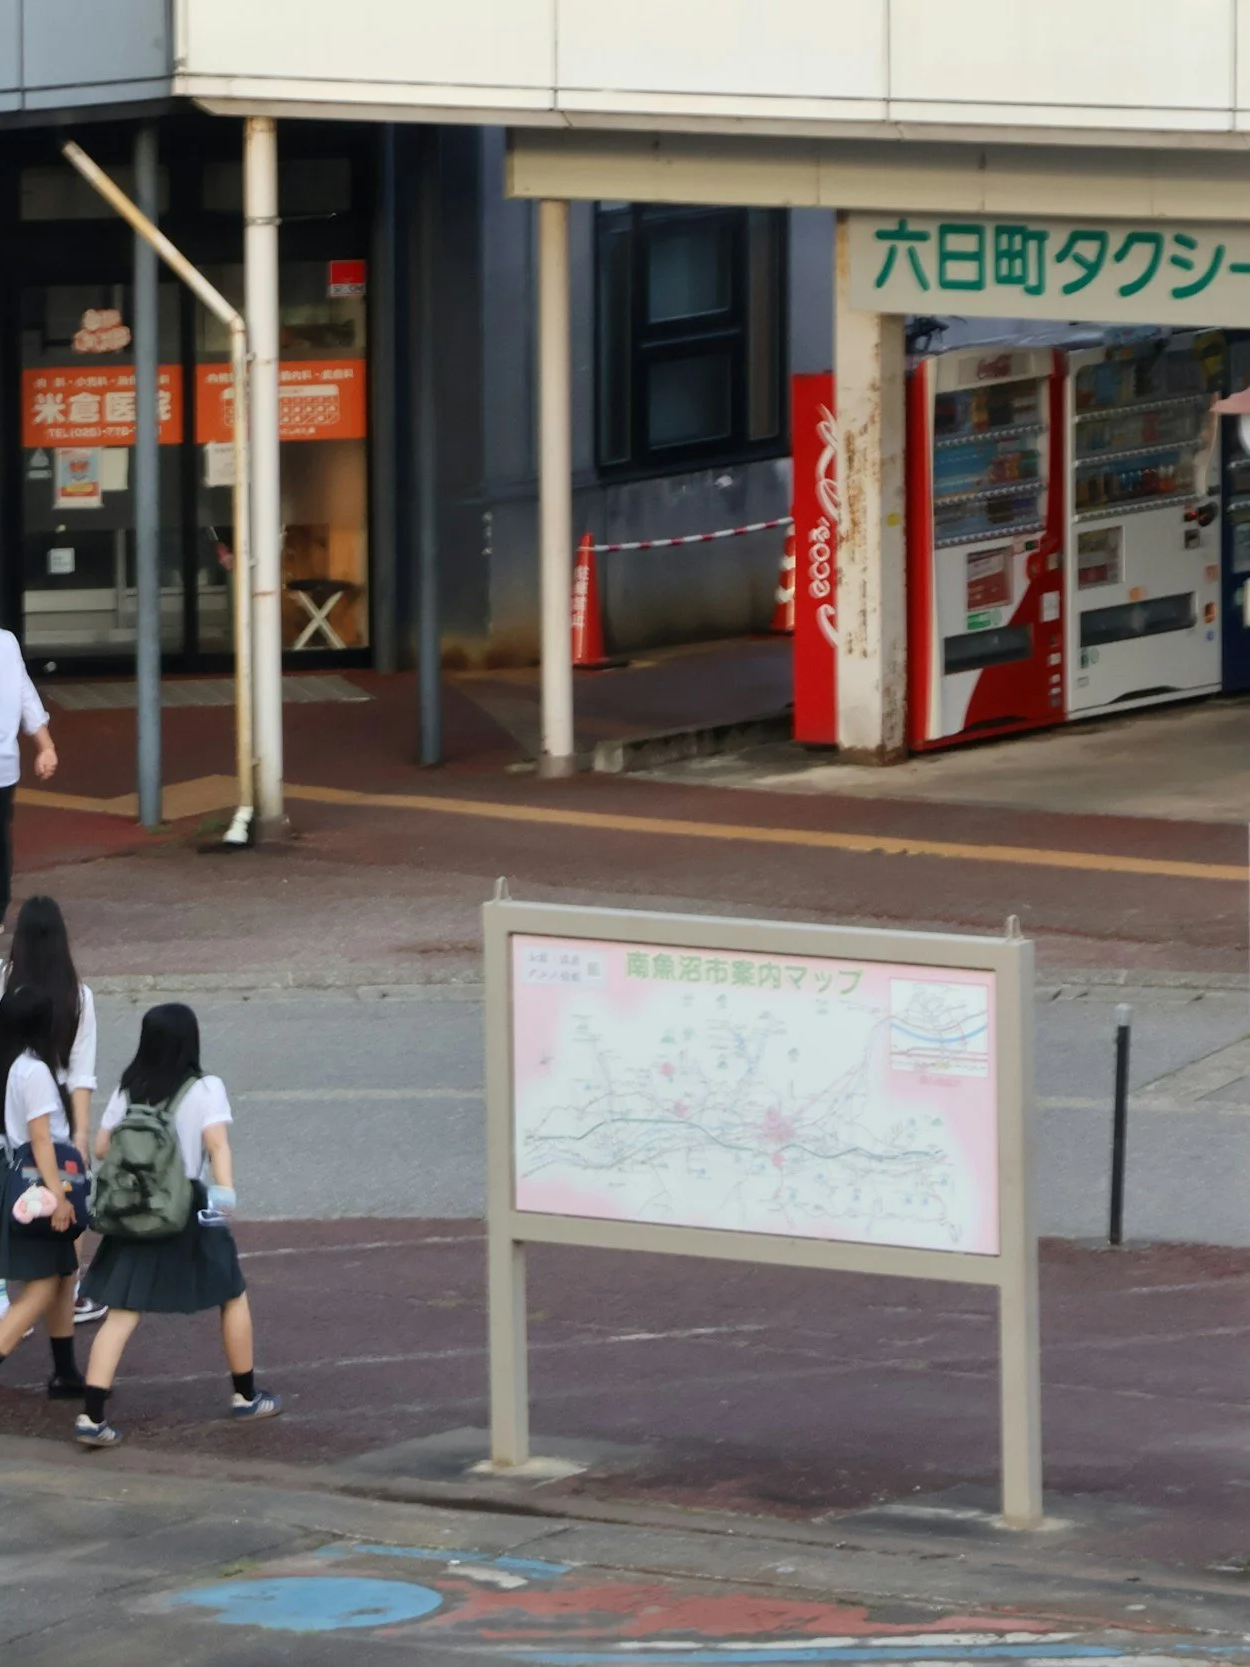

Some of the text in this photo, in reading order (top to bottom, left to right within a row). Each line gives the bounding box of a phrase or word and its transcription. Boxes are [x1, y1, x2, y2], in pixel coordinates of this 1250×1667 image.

[624, 950, 864, 996] 南魚沼市案内マップ
